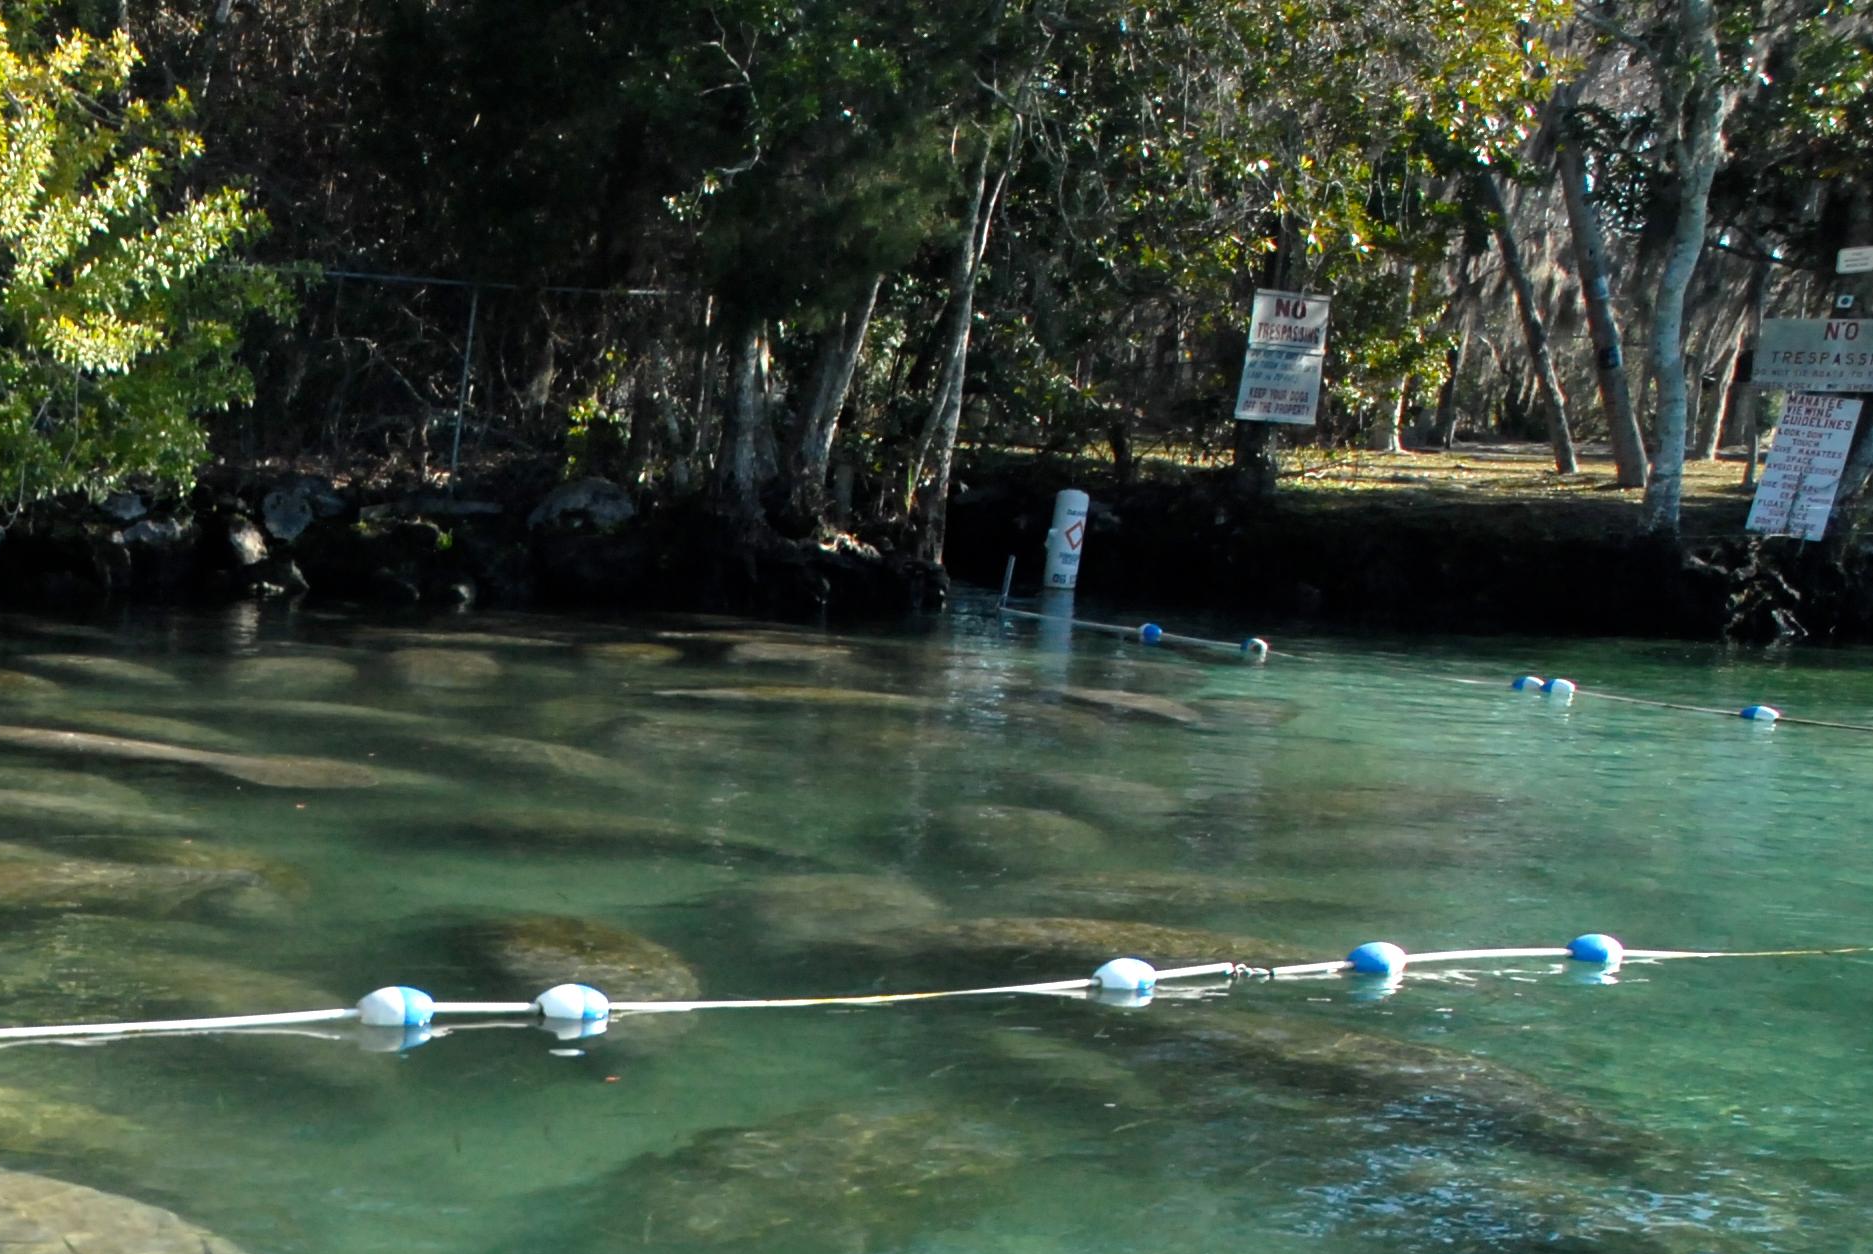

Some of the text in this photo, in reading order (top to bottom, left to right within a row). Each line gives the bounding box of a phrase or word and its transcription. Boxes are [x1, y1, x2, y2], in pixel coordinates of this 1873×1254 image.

[1275, 298, 1306, 319] NO
[1257, 322, 1320, 344] TRESPASSING
[1824, 322, 1859, 340] NO
[1788, 393, 1845, 410] MANATEE
[1787, 405, 1833, 418] VIEWING
[1782, 415, 1853, 430] GUIDELINES
[1792, 438, 1821, 447] TOUCH
[1797, 448, 1843, 459] MANATEES
